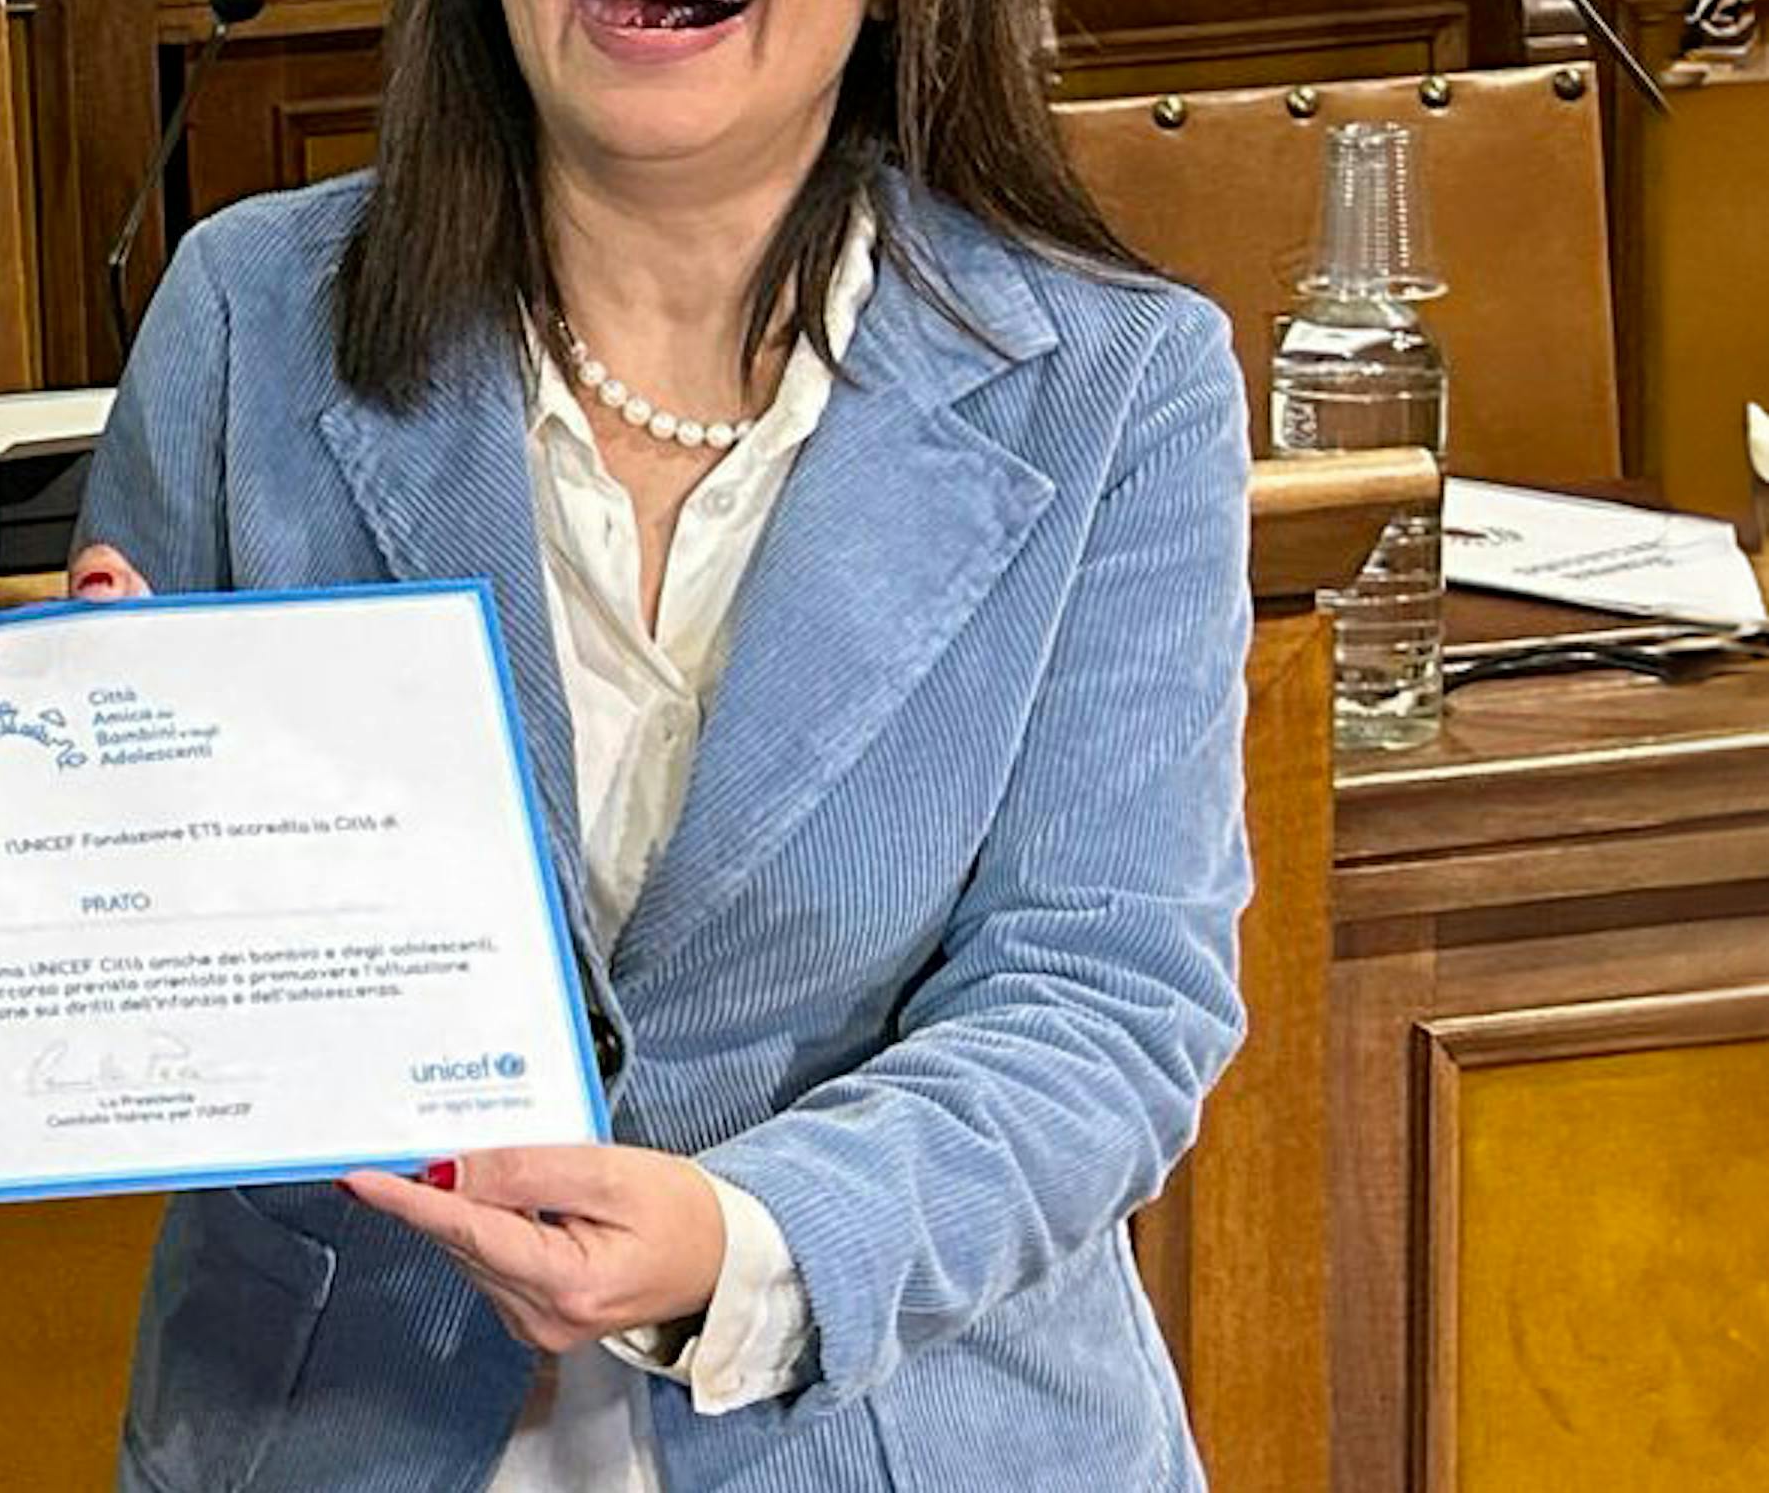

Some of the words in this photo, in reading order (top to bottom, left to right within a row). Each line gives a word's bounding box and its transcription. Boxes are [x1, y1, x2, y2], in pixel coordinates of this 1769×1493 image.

[88, 688, 137, 706] Città
[92, 708, 153, 726] Amica
[97, 725, 176, 746] Bambini
[100, 745, 212, 766] Adolescenti
[81, 827, 184, 848] Fondazione
[81, 892, 151, 914] PRATO
[30, 958, 91, 976] UNICEF
[149, 951, 211, 969] amiche
[64, 977, 138, 996] previsto
[249, 965, 359, 985] promuovere
[411, 1053, 490, 1084] unicef
